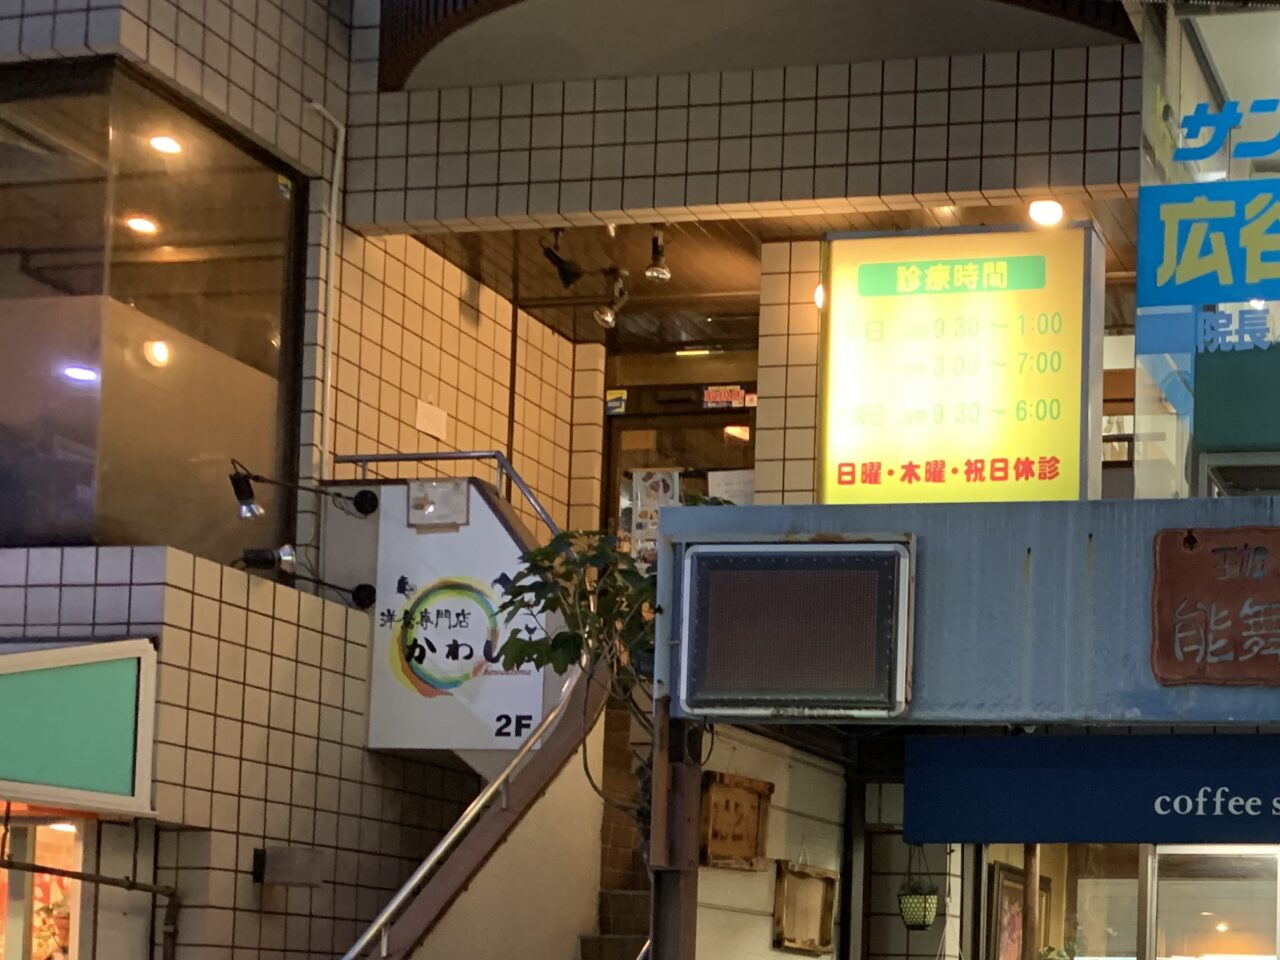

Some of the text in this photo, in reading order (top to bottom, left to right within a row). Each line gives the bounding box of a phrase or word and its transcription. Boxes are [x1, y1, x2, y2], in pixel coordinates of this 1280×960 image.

[896, 261, 1008, 293] 診療時間
[837, 456, 1061, 485] 日曜・木曜・祝日休診
[405, 637, 506, 665] かわし
[495, 715, 533, 737] 2F
[1154, 786, 1262, 816] coffee
